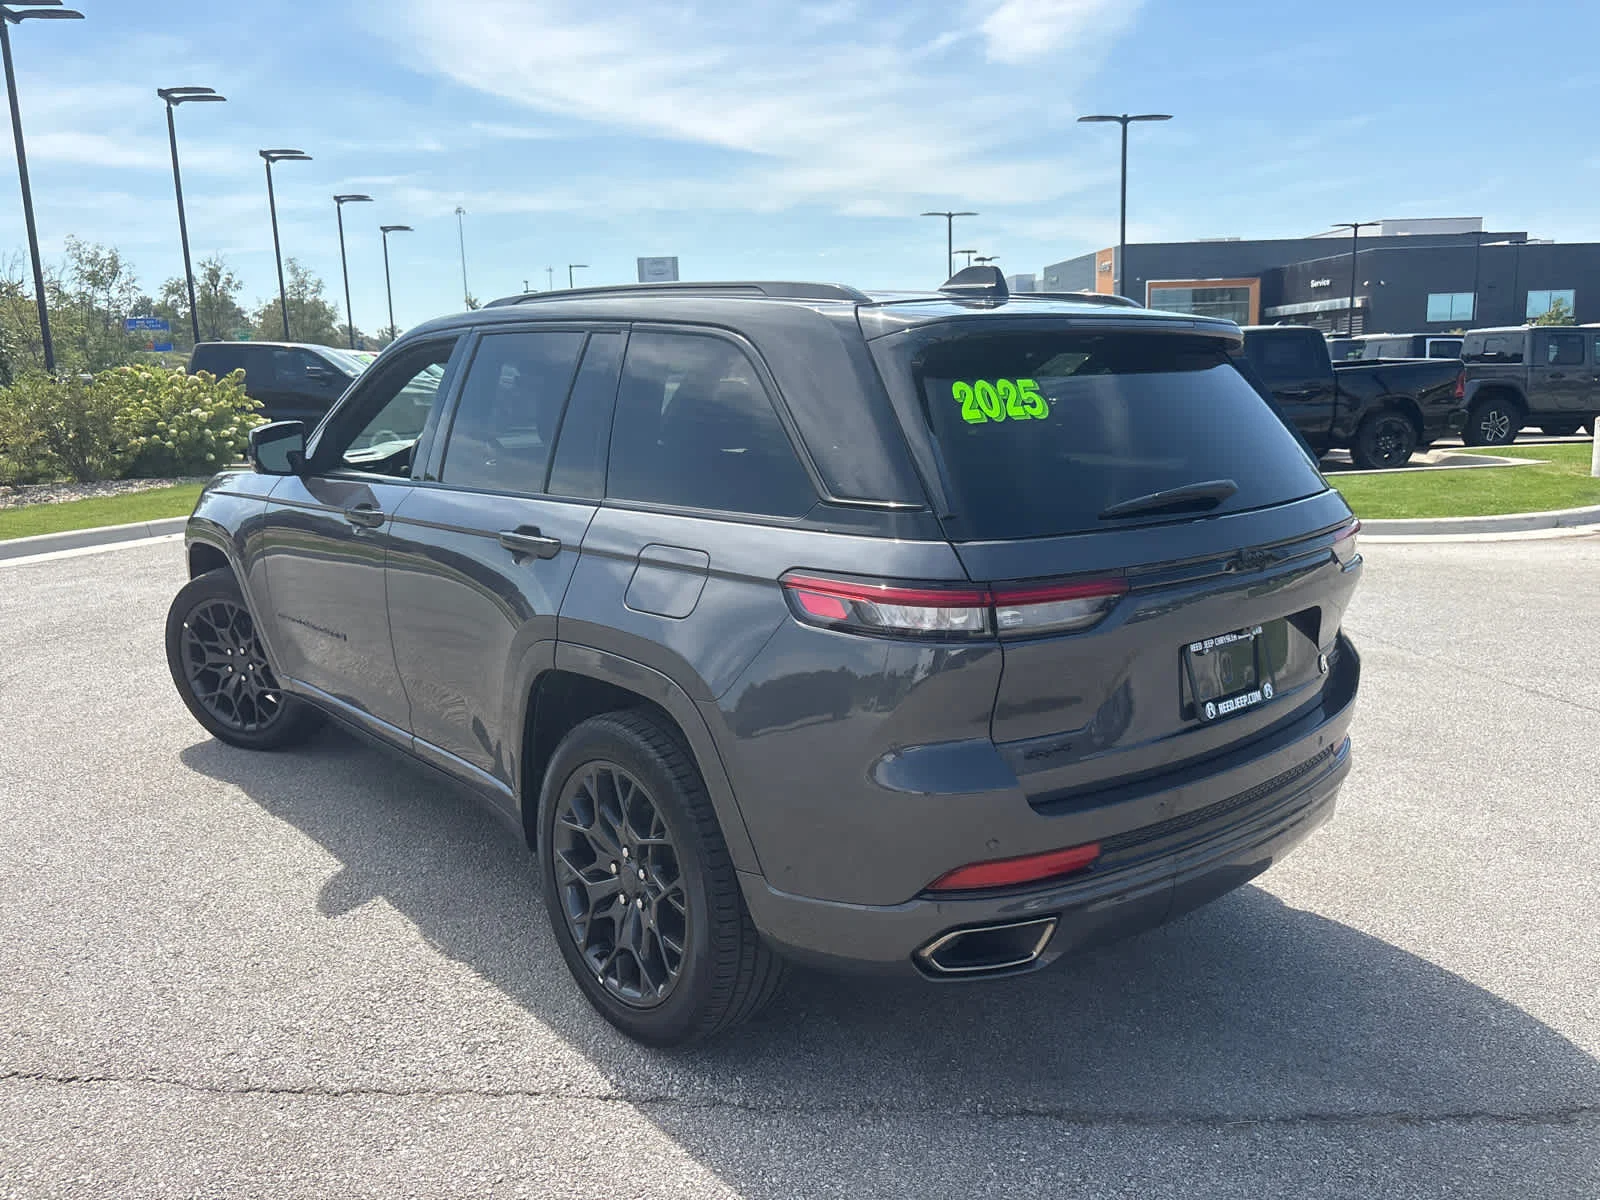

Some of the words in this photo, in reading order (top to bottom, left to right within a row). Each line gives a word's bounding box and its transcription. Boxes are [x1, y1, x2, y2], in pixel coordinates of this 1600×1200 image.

[1310, 278, 1330, 288] Service
[952, 379, 1049, 424] 2025
[1190, 642, 1203, 653] REED
[1203, 639, 1214, 649] JEEP
[1218, 690, 1262, 714] REEDJEEP.COM
